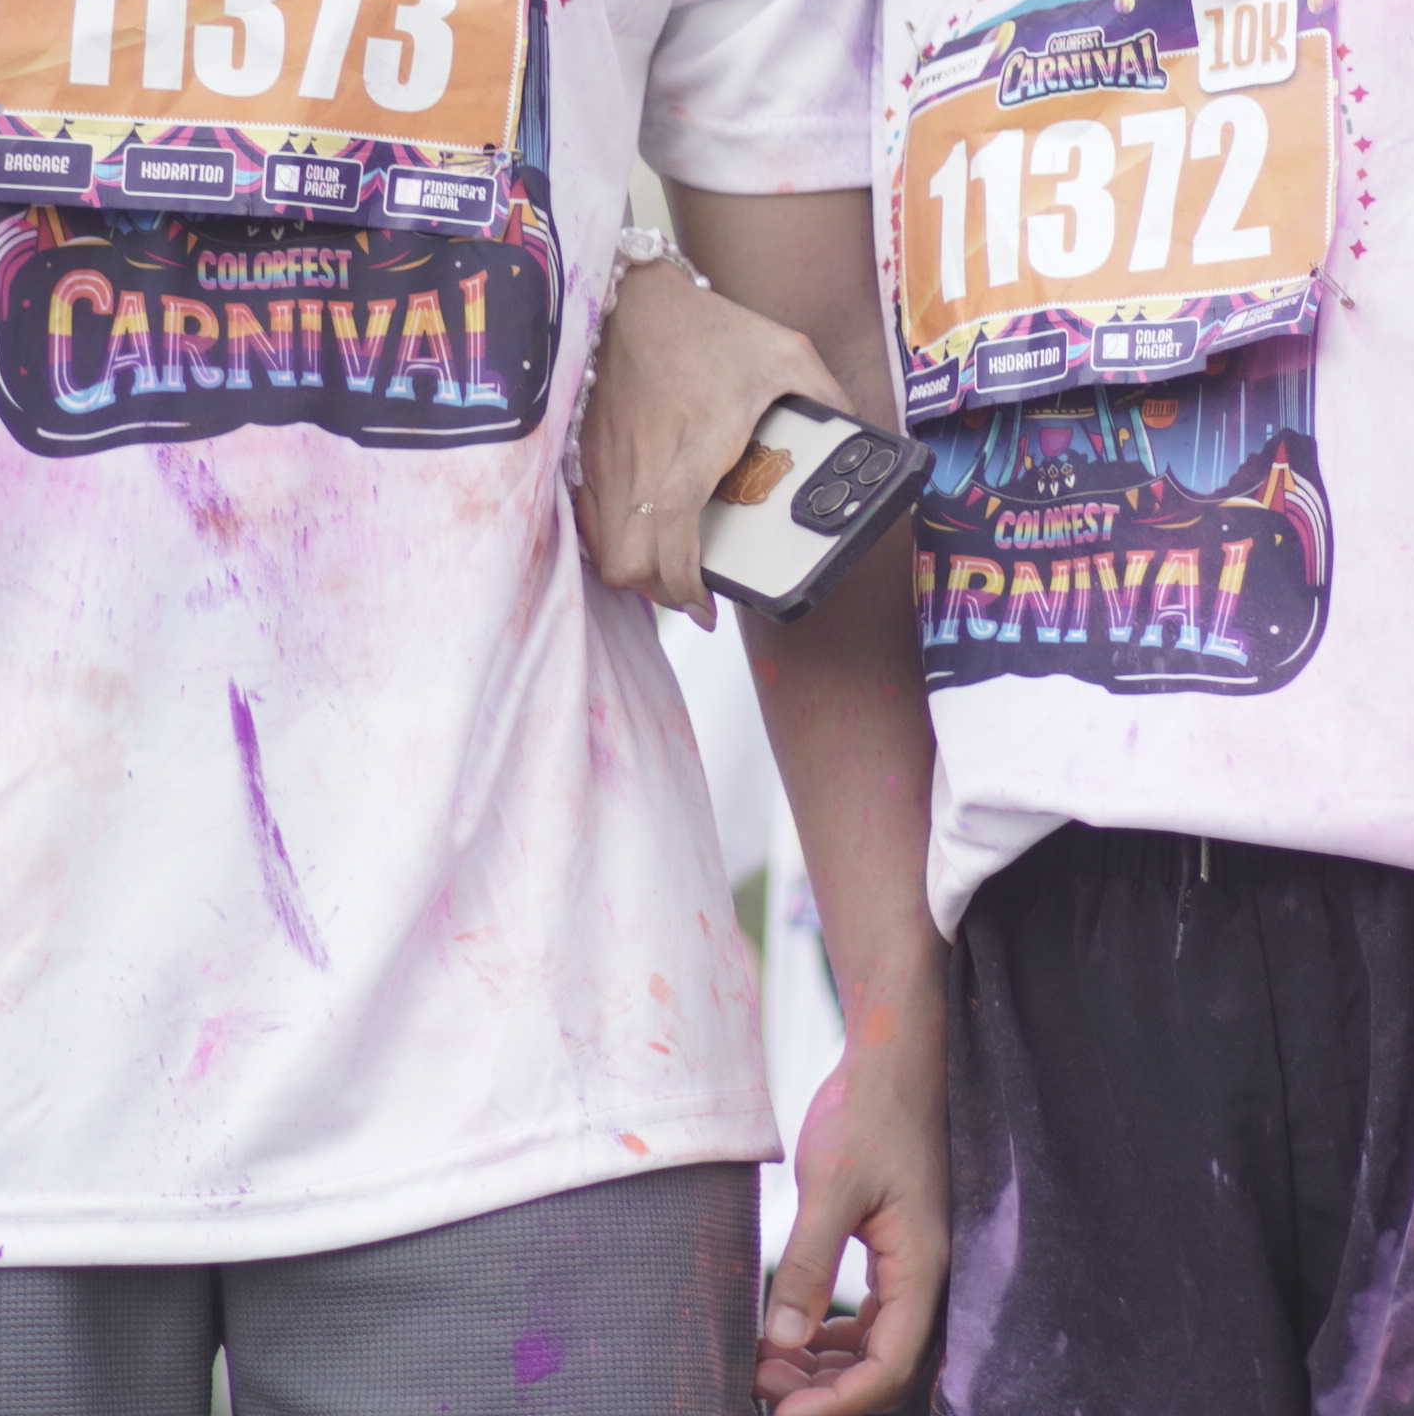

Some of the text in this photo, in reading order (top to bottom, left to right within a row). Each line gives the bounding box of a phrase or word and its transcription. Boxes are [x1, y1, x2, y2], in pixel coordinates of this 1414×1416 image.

[1049, 32, 1101, 54] COLORFEST
[1203, 2, 1288, 72] 10K
[1002, 35, 1166, 103] CARNIVAL
[4, 153, 70, 175] BAGGAGE
[140, 160, 224, 184] HYDRATION
[305, 164, 340, 183] COLOR
[303, 180, 347, 201] PACKET
[423, 179, 487, 202] FINISHER'S
[930, 94, 1271, 304] 11372
[421, 193, 461, 213] MEDAL
[197, 248, 352, 291] COLORFEST
[48, 269, 507, 414] CARNIVAL
[1135, 328, 1174, 344] COLOR
[988, 346, 1061, 375] HYDRATION
[1134, 342, 1183, 361] PACKET
[994, 502, 1120, 550] COLORFEST
[916, 537, 1254, 667] ARNIVAL
